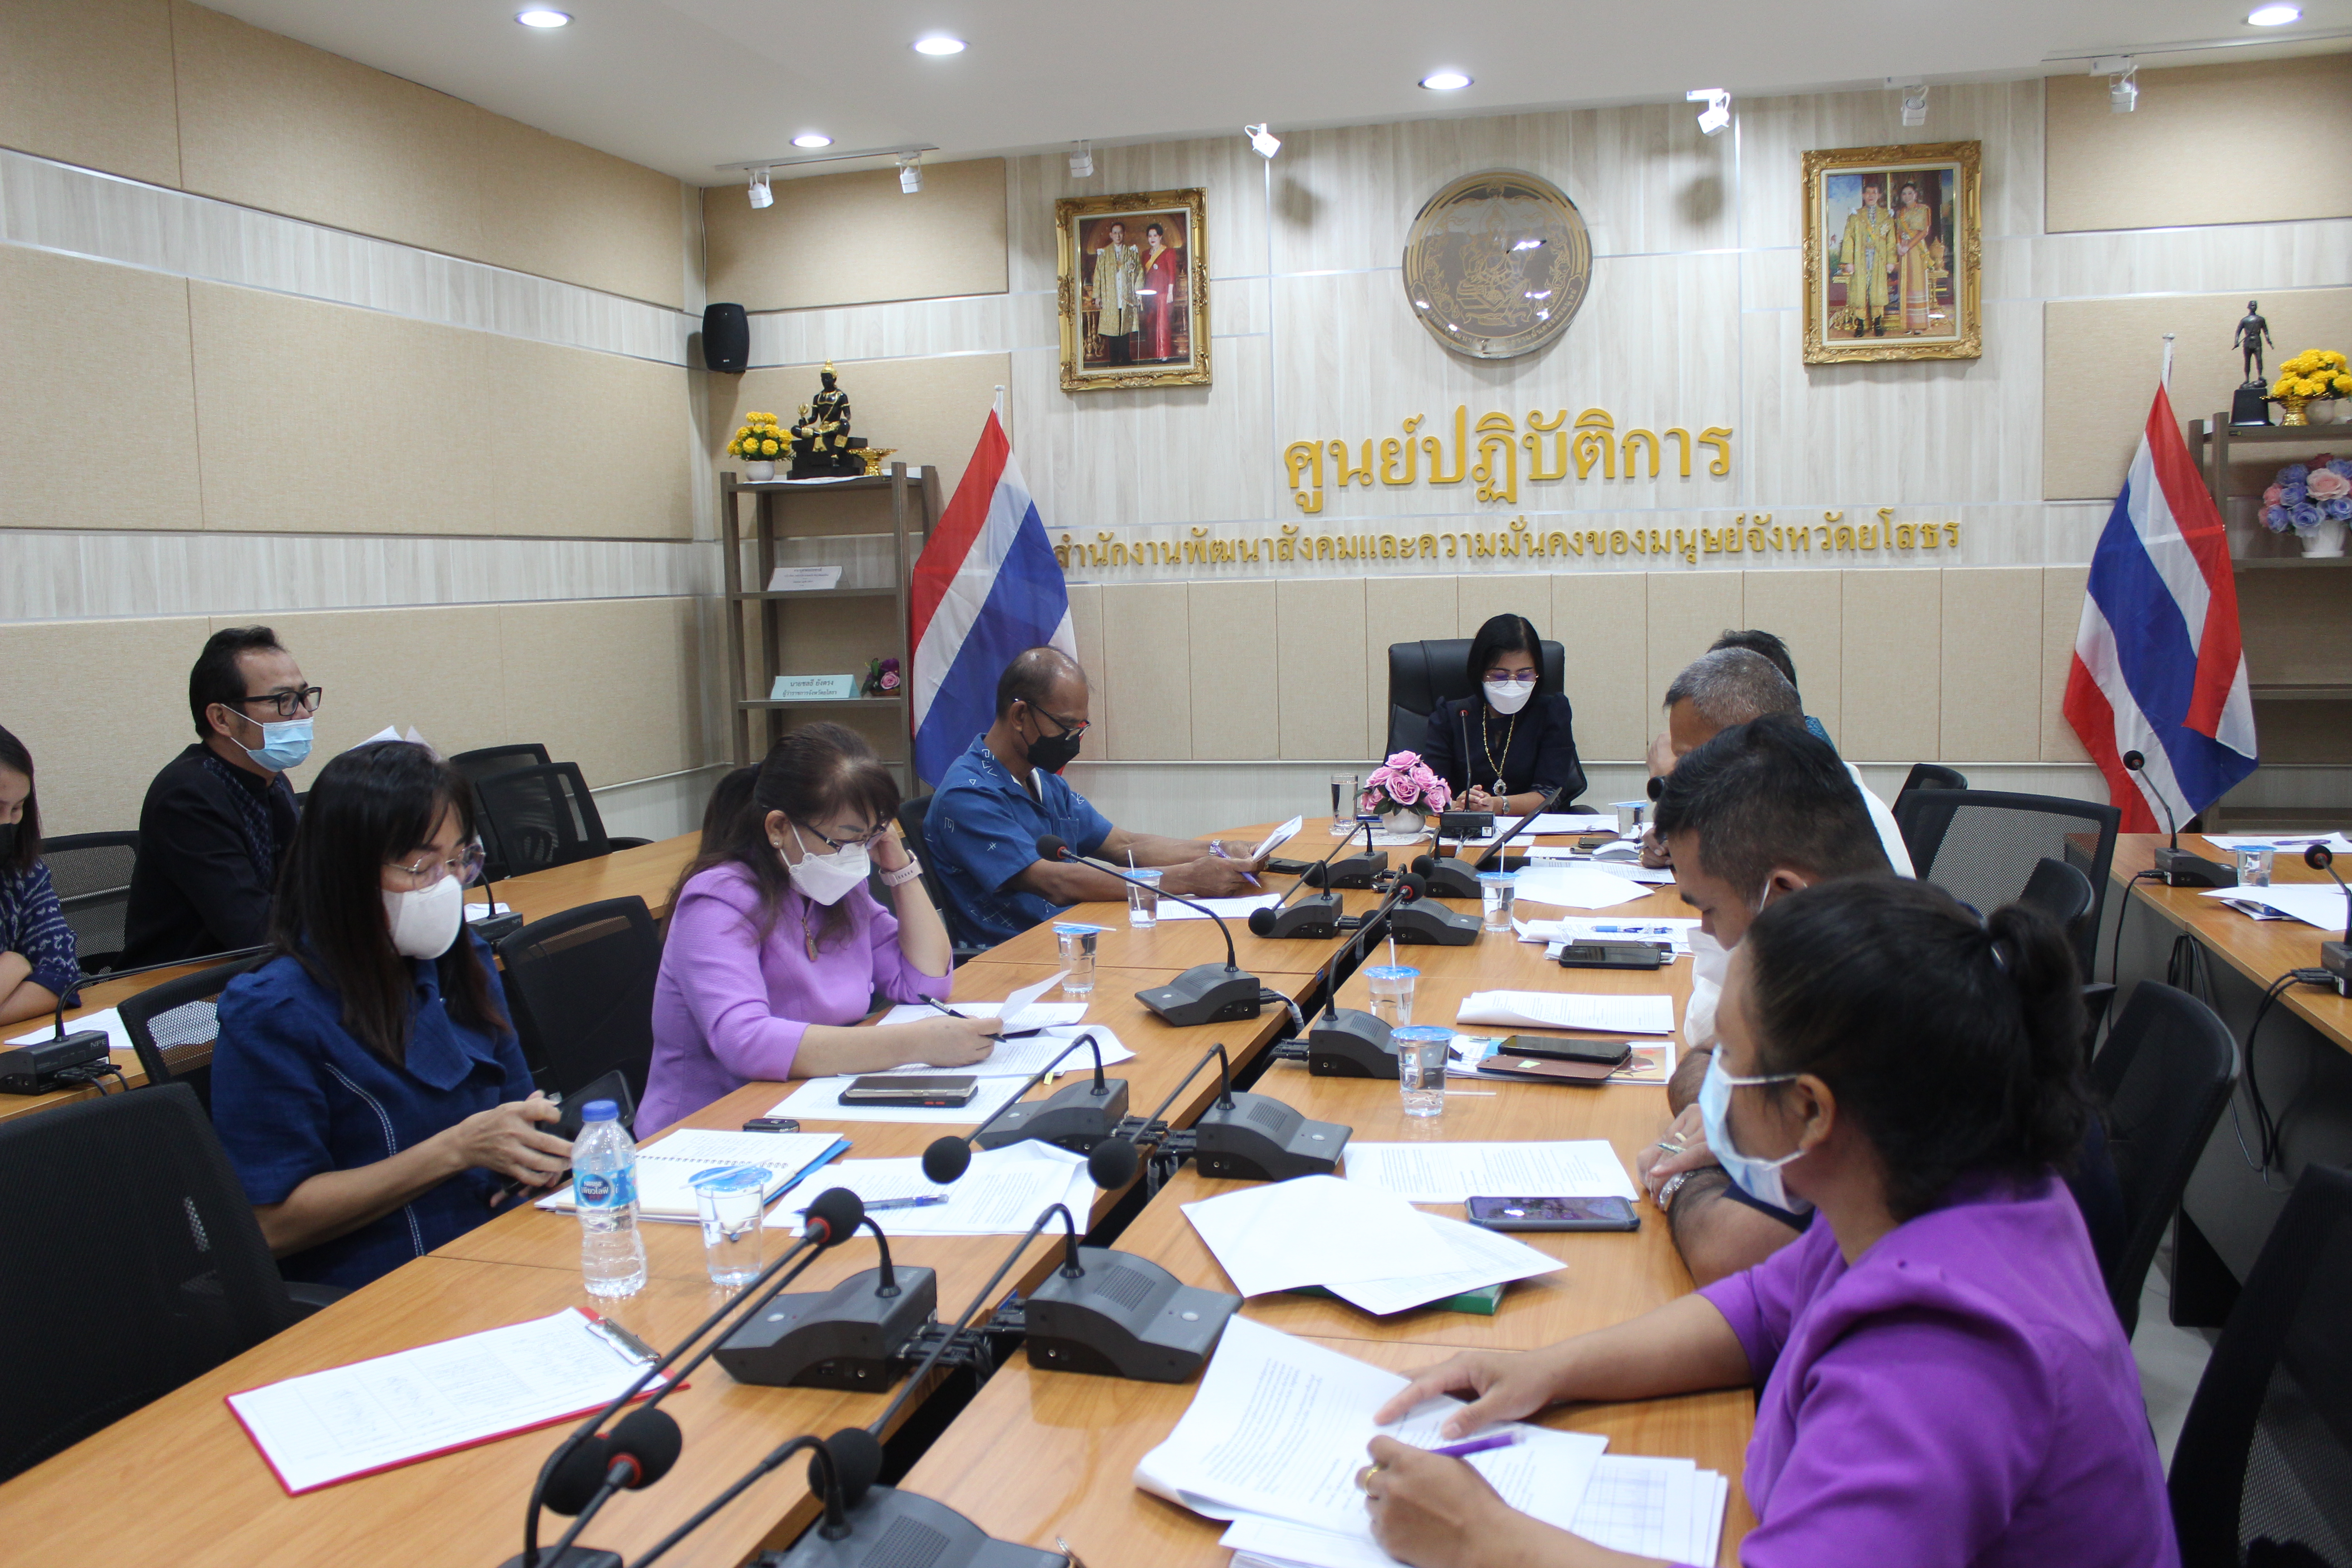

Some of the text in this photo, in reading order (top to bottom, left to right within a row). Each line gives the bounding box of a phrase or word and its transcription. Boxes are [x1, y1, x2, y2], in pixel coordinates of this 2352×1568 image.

[1284, 404, 1733, 513] ศูนย์ปฏิบัติการ
[1053, 507, 1960, 568] สำนักงานพัฒนาสังคมและความมั่นคงของมนุษย์จังหวัดยโสธร
[91, 1039, 107, 1048] NPE
